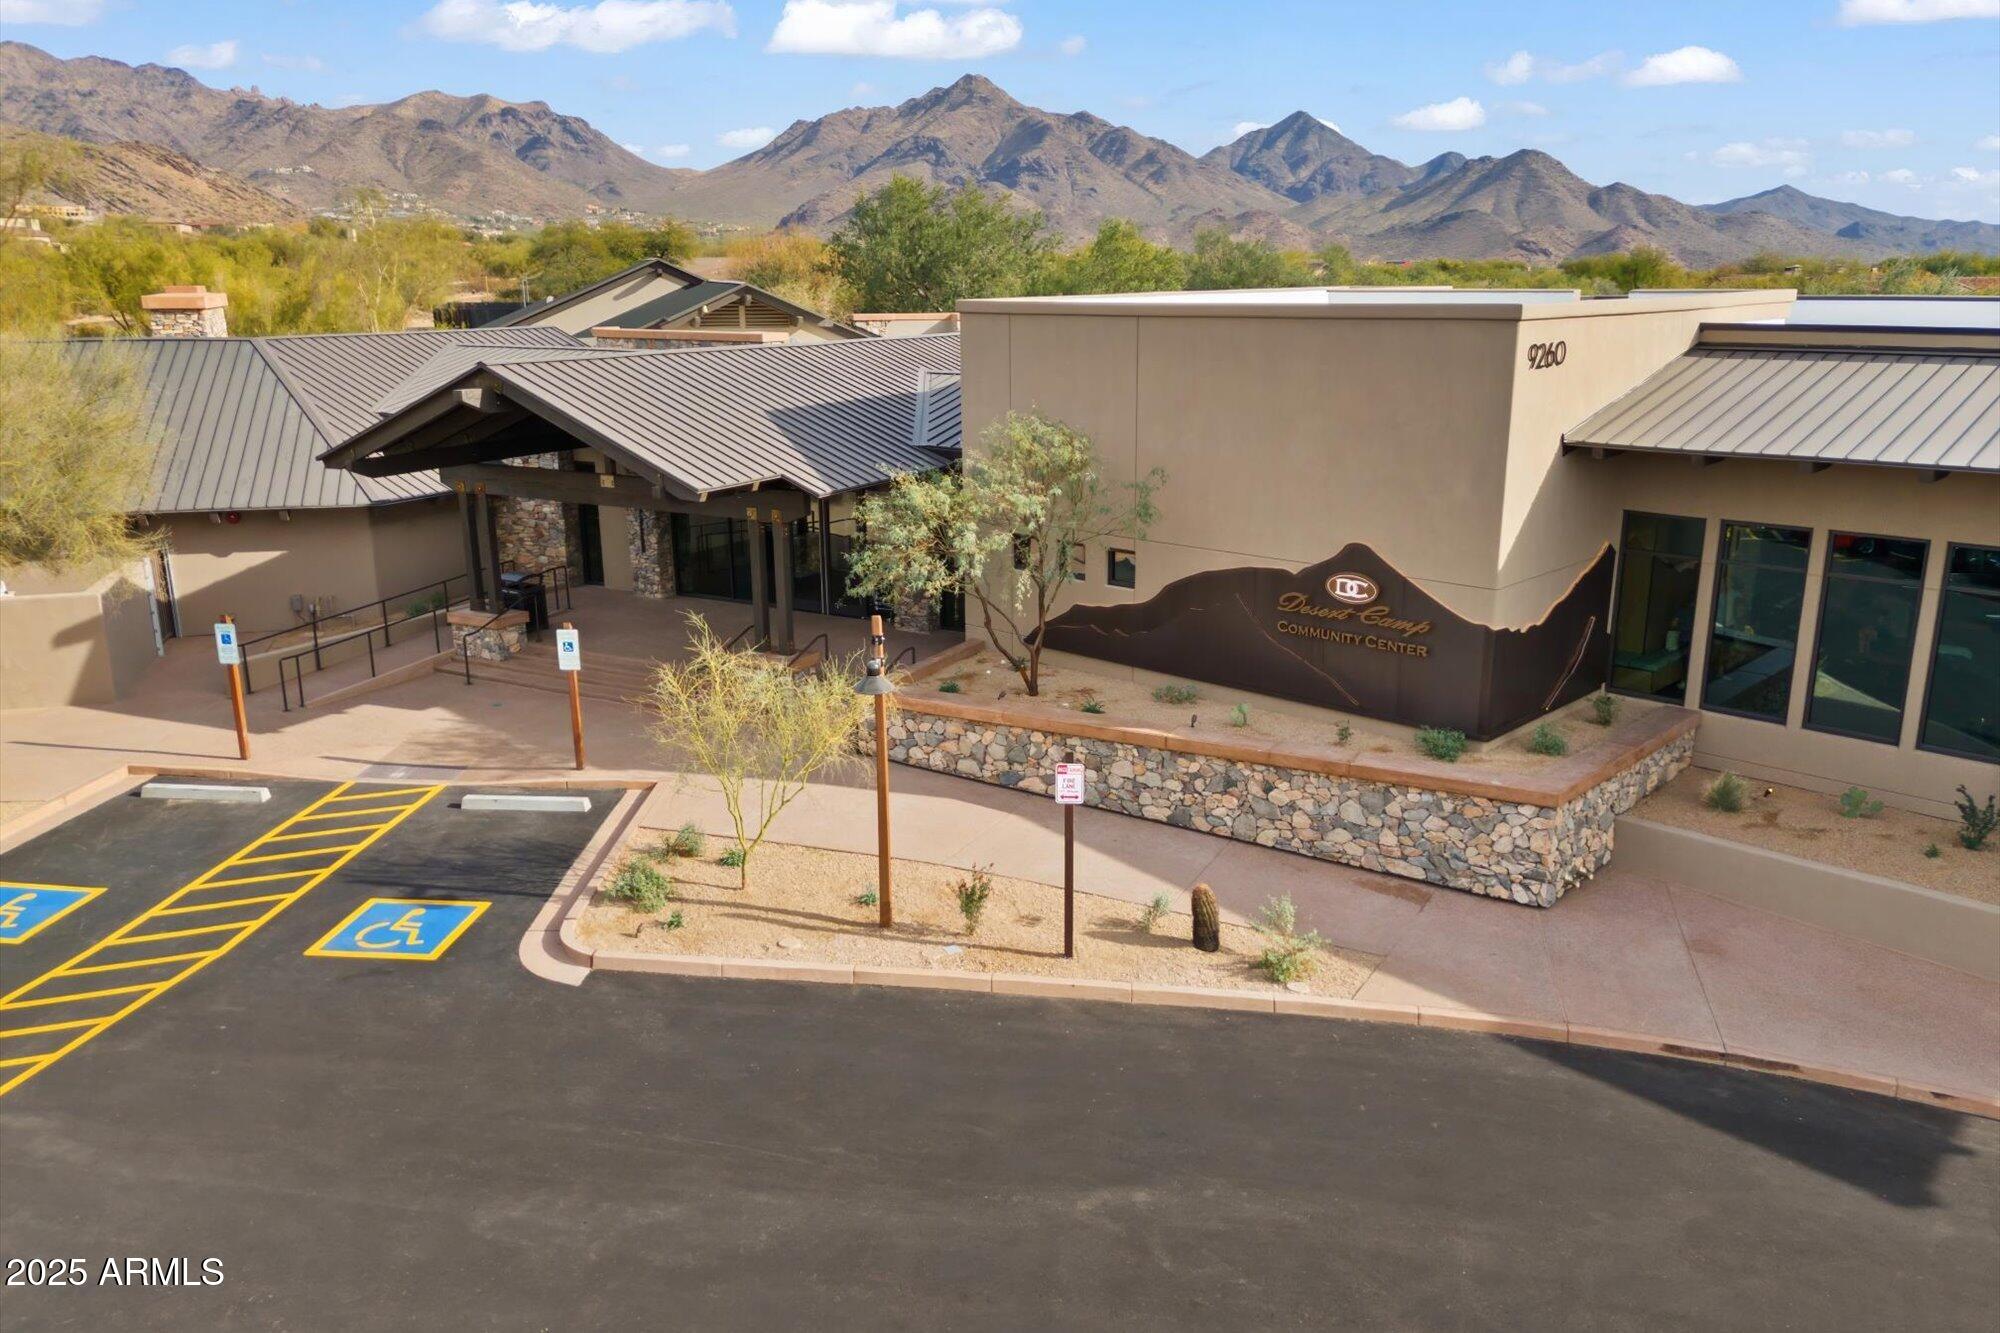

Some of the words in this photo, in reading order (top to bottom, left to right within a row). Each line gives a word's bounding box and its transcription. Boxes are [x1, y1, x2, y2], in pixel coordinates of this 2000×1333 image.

[1528, 341, 1567, 369] 9260
[1277, 592, 1355, 621] Desert
[1357, 605, 1432, 637] Camp
[1277, 620, 1362, 646] COMMUNITY
[1365, 635, 1429, 658] CENTER
